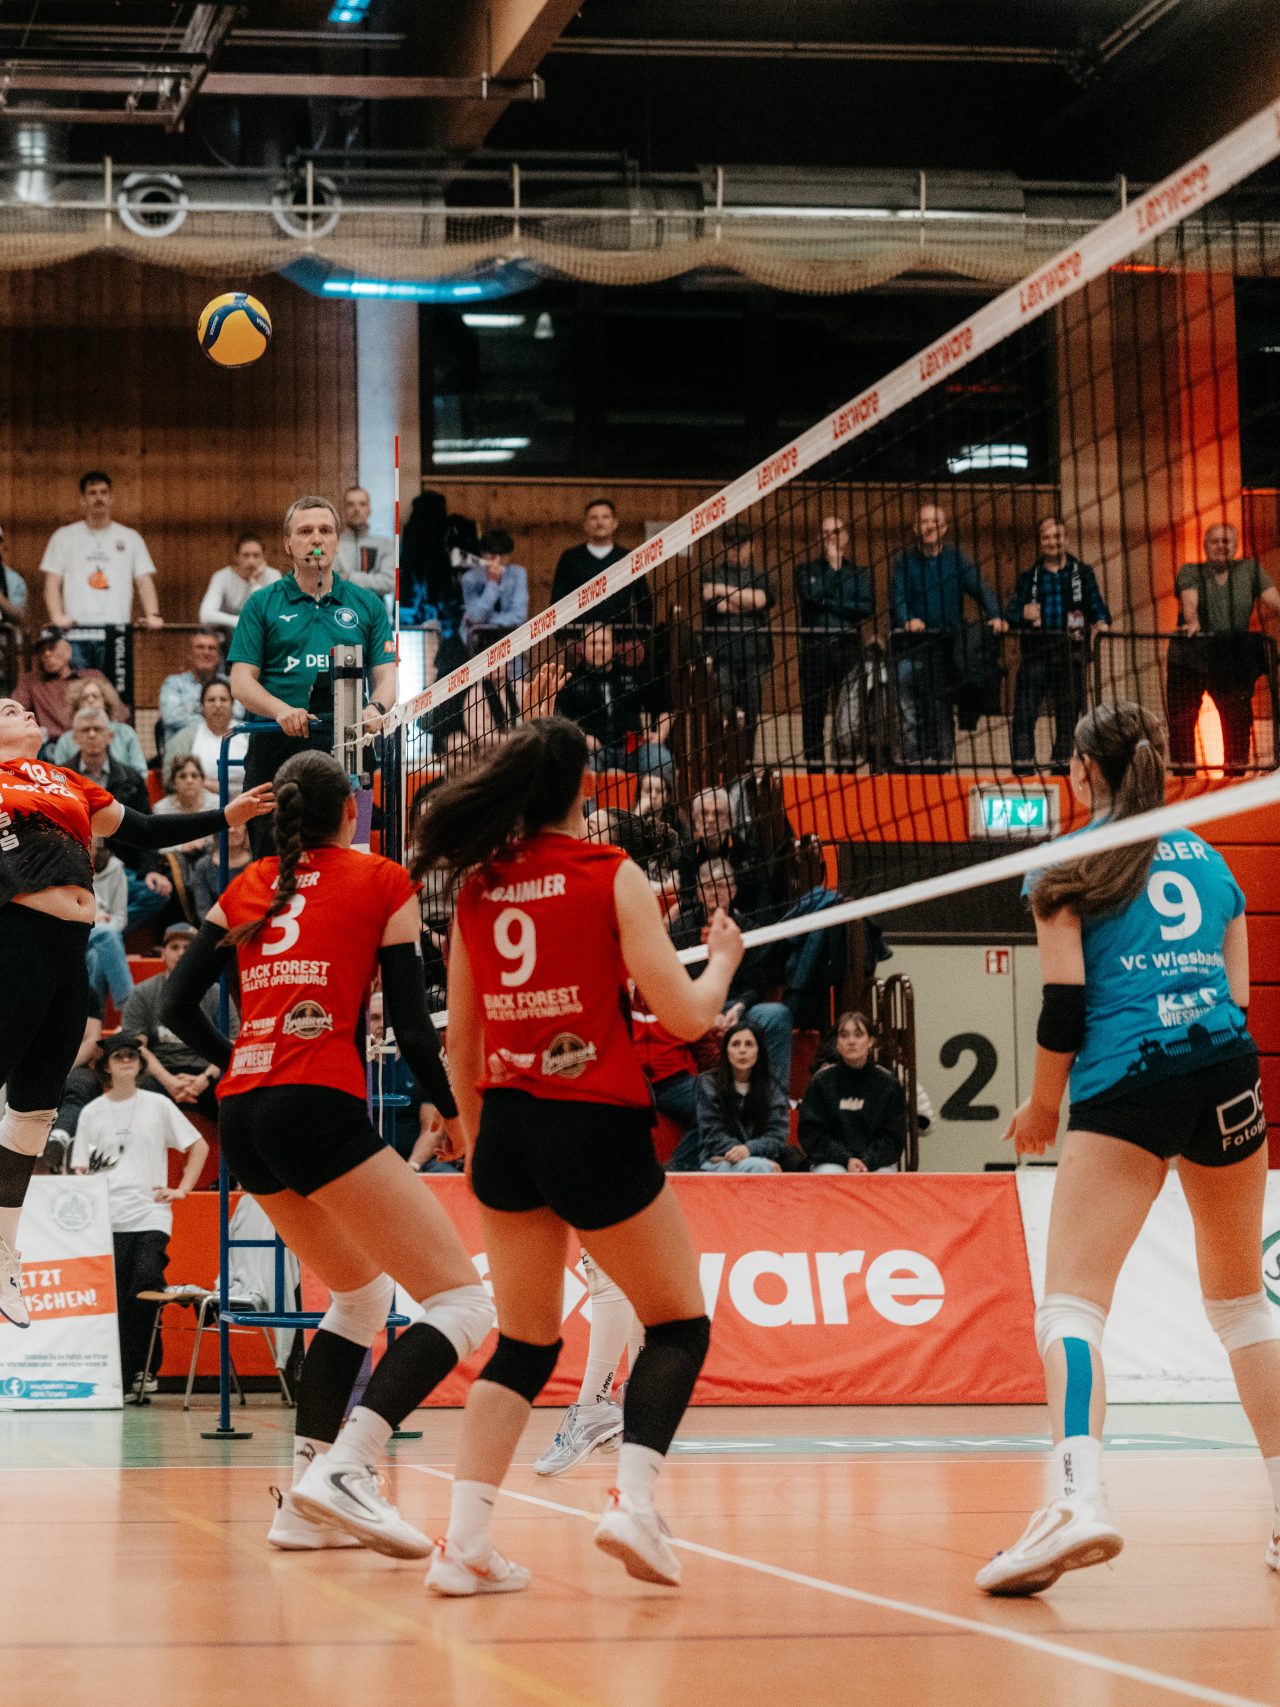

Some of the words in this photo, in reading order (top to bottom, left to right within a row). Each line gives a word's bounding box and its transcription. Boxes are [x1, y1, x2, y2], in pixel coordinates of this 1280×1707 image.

[690, 496, 726, 535] Lexware
[631, 538, 664, 575] Lexware
[578, 575, 607, 608] Lexware
[1146, 870, 1203, 942] 9
[261, 893, 307, 956] 3
[493, 907, 537, 988] 9
[1120, 954, 1147, 971] VC
[273, 959, 331, 976] FOREST
[516, 985, 580, 1009] FOREST
[939, 1032, 1000, 1122] 2
[19, 1268, 62, 1290] ETZT
[601, 1371, 614, 1394] CRAFT
